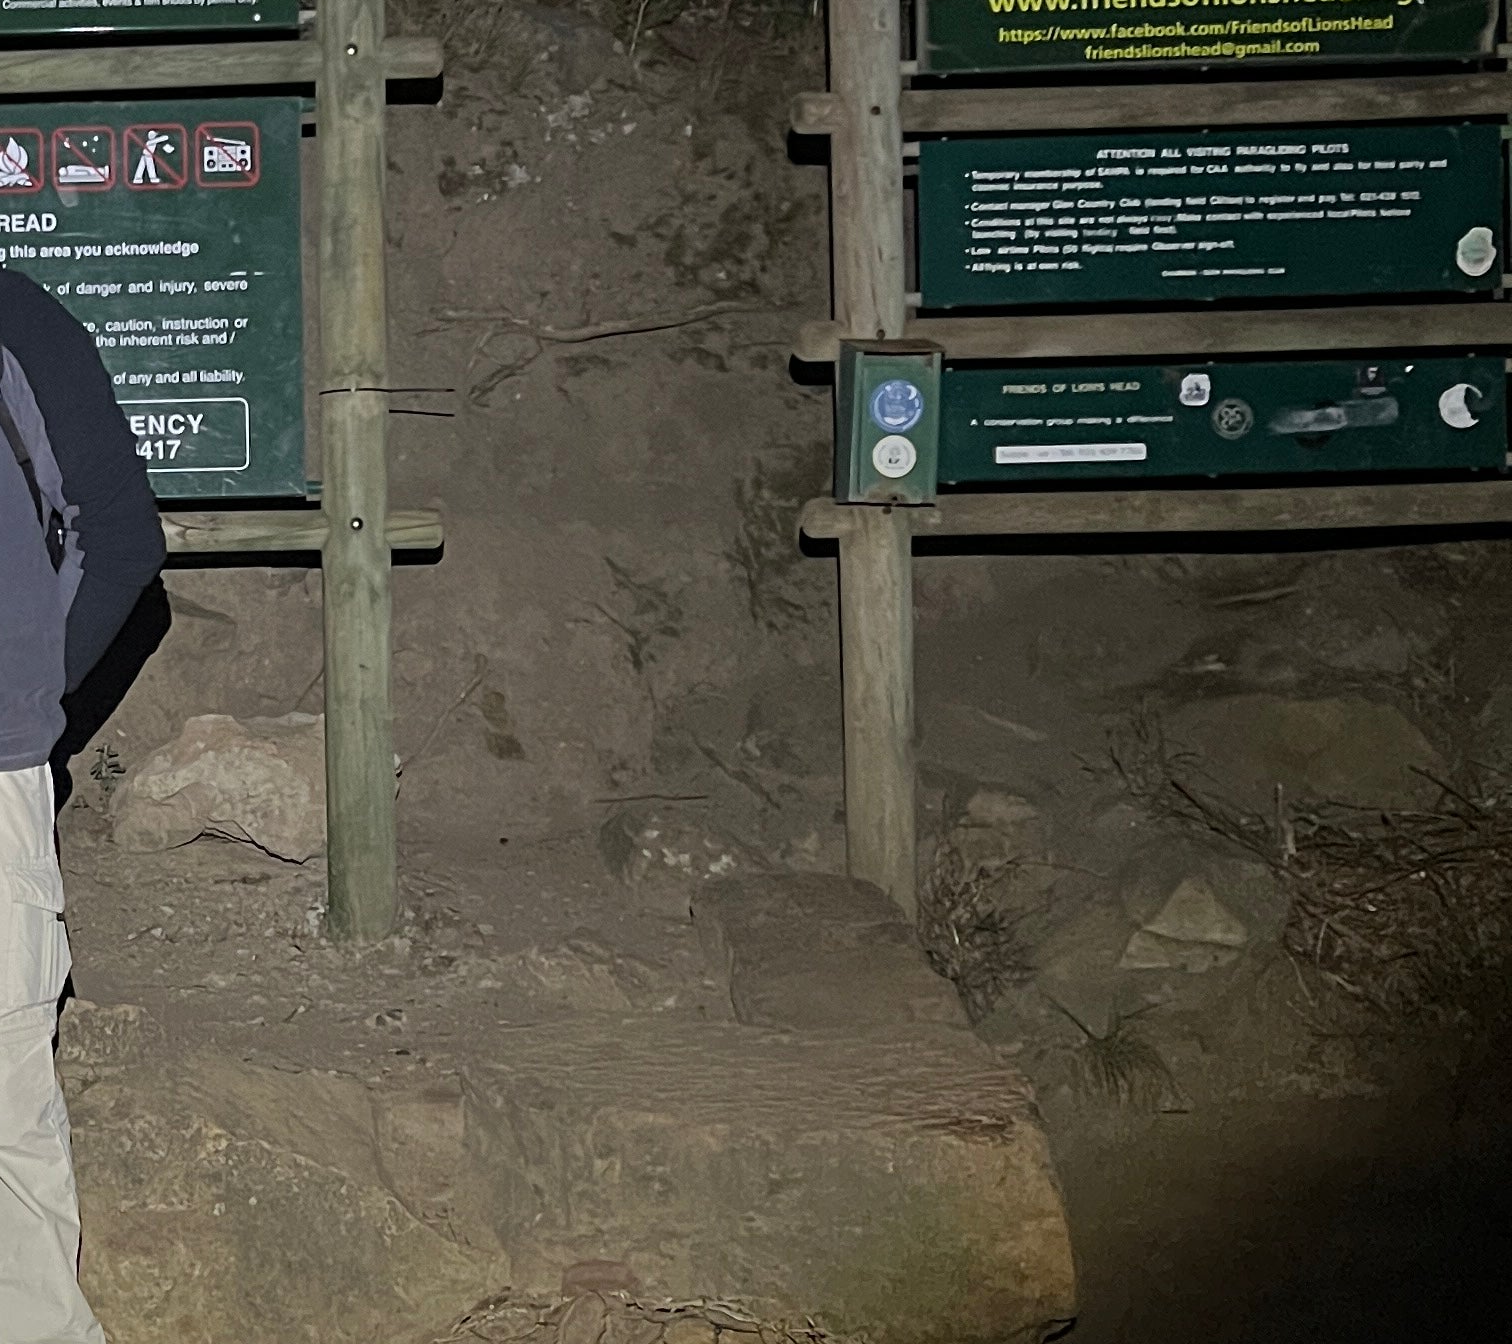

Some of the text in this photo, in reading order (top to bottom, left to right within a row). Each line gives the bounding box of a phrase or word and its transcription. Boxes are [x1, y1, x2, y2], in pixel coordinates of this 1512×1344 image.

[999, 15, 1393, 44] https://www.facebook.com/FriendsofLionsHead
[1085, 40, 1319, 61] friendslionshead@gmail.com
[10, 245, 36, 258] this
[40, 247, 71, 257] area
[75, 246, 101, 259] you
[105, 241, 199, 256] acknowledge
[57, 282, 70, 295] of
[76, 283, 122, 297] danger
[128, 281, 153, 293] and
[160, 280, 197, 295] injury,
[204, 280, 247, 291] severe
[96, 332, 235, 347] the inherent risk and /
